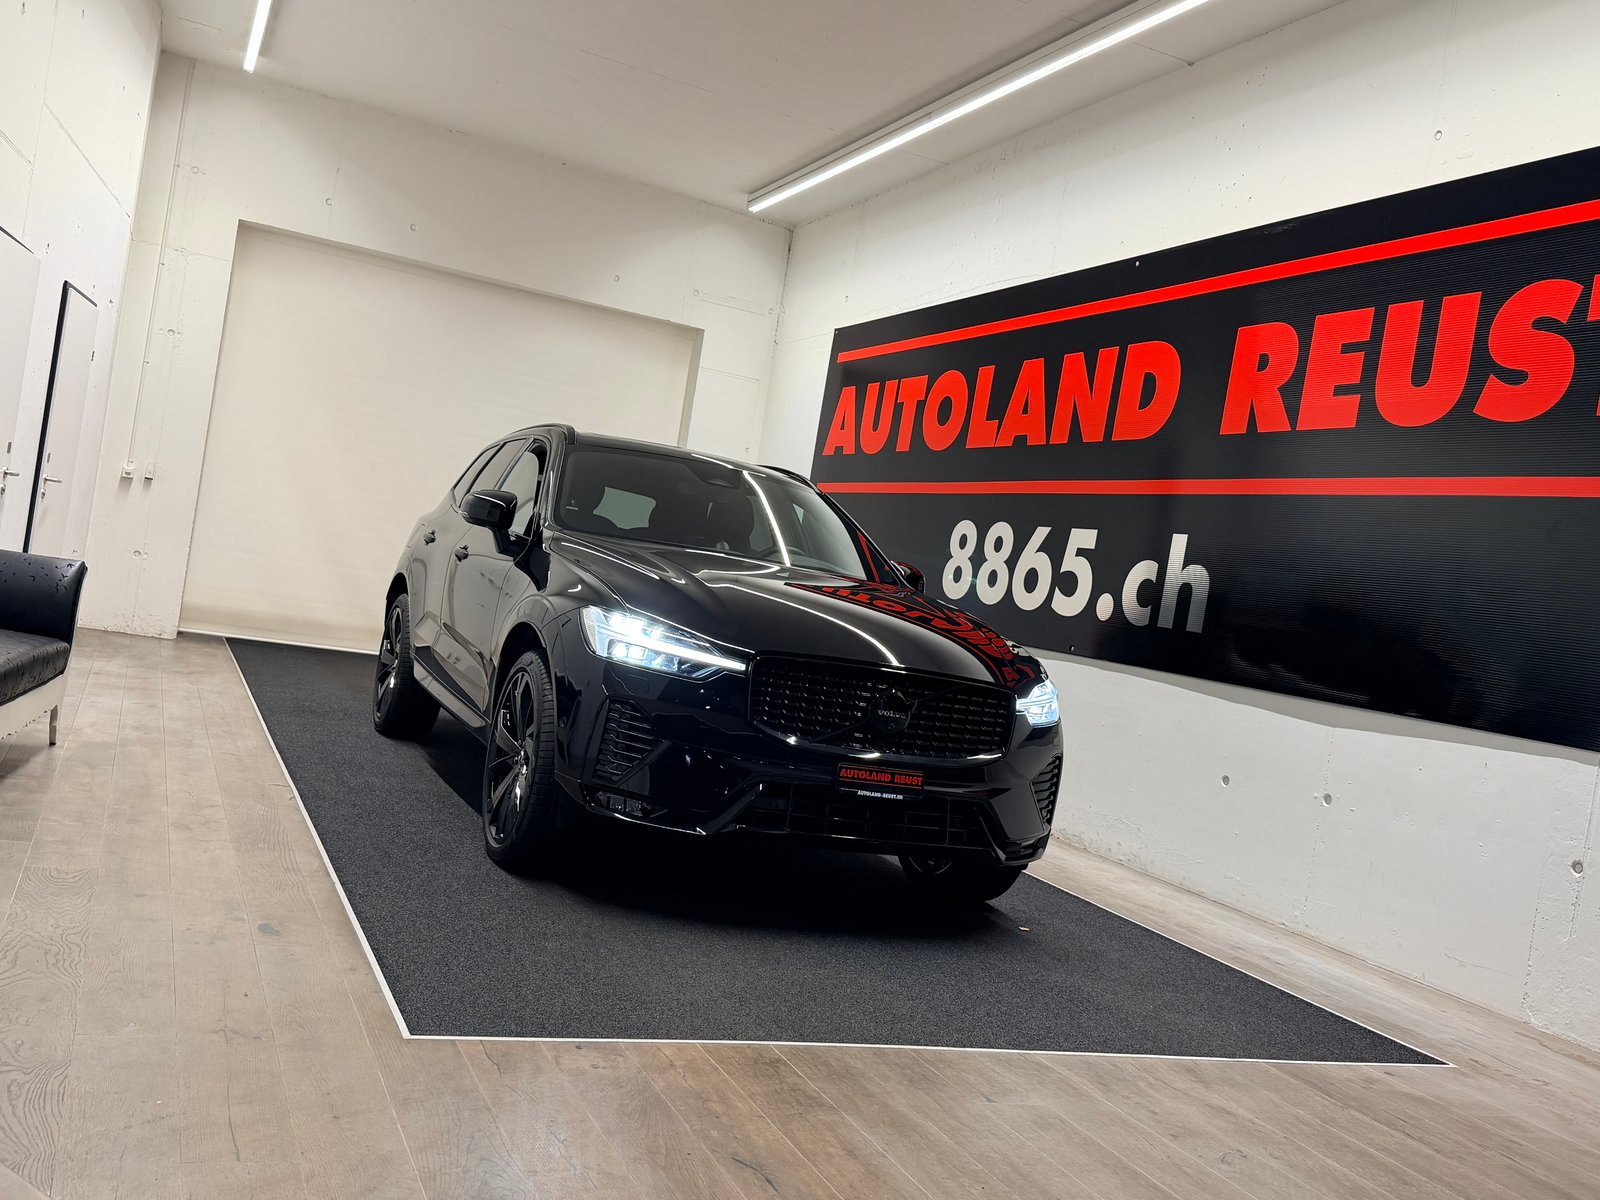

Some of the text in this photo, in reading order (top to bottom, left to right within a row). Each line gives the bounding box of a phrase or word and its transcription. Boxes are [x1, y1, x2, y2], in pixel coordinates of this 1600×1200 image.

[822, 273, 1600, 456] AUTOLAND REUS
[942, 519, 1211, 633] 8865.ch
[839, 768, 923, 785] AUTOLAND REUST
